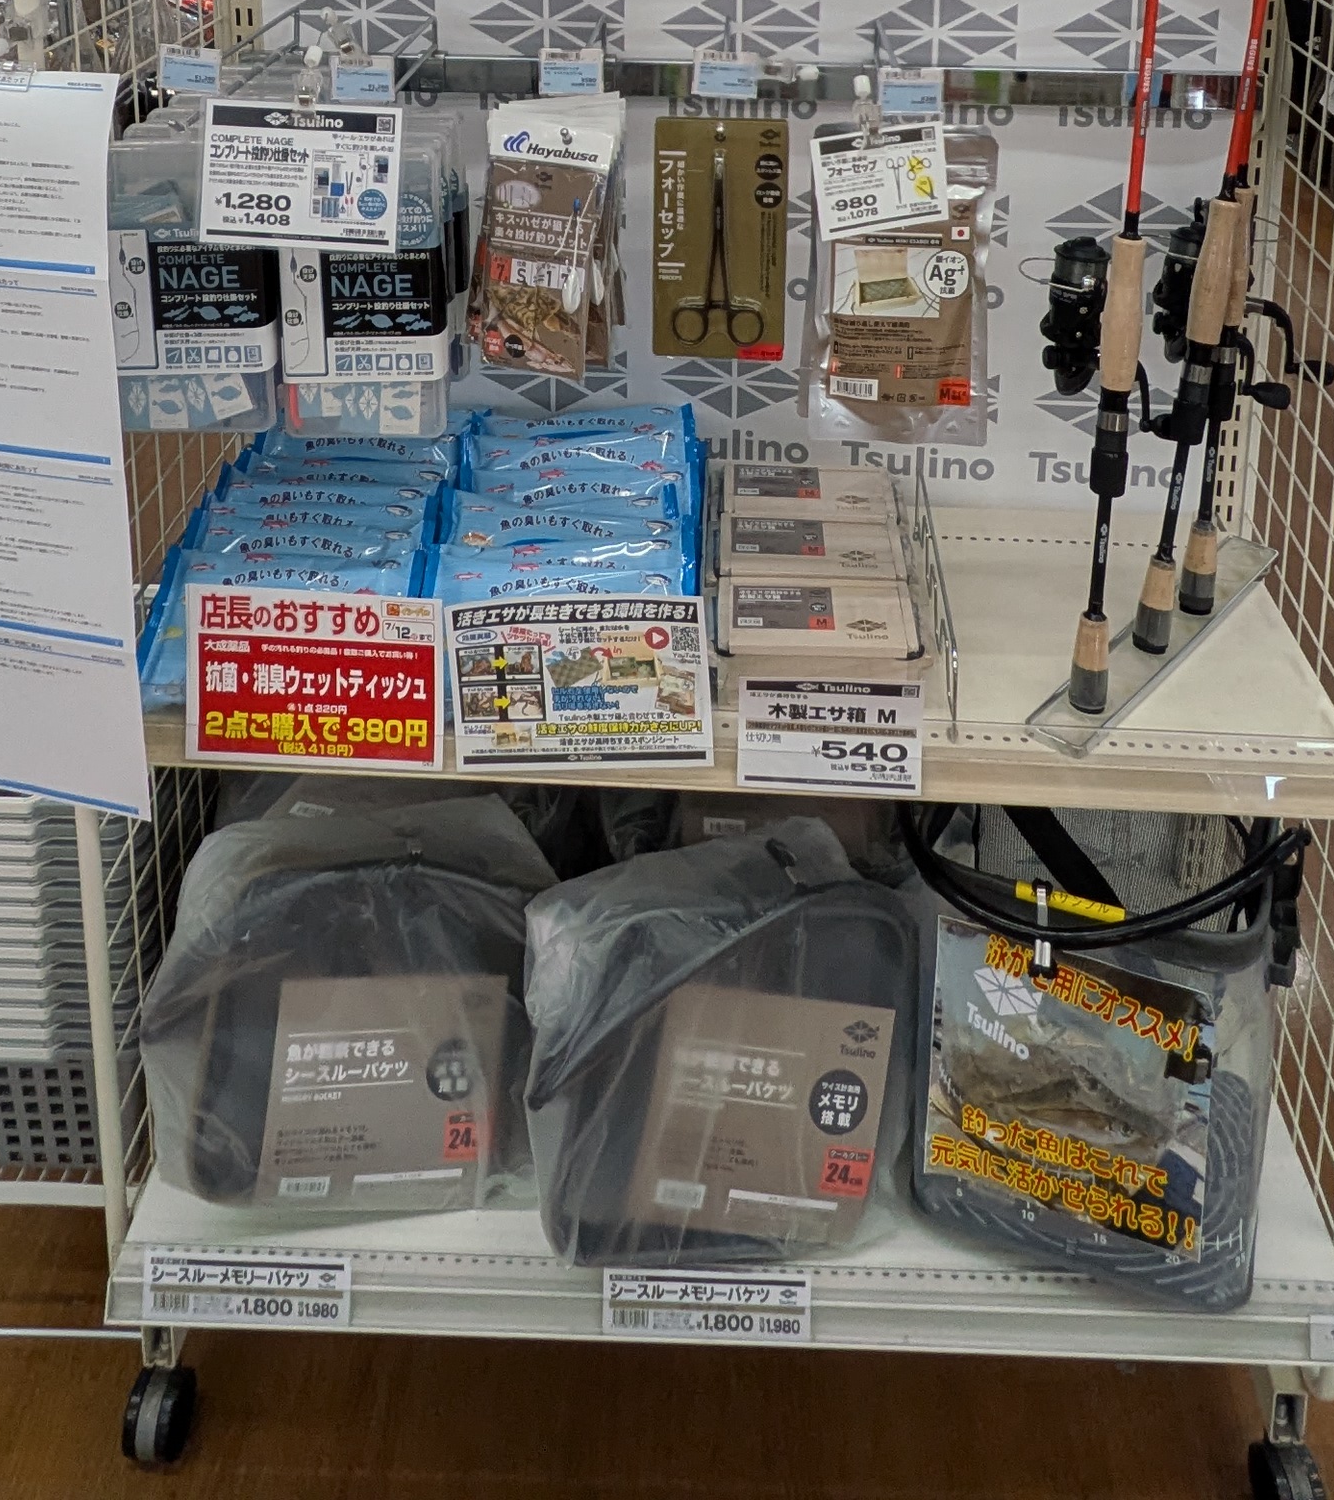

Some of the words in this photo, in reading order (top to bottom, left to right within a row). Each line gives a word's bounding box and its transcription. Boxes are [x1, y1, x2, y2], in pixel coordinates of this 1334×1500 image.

[211, 134, 262, 145] COMPLETE
[266, 136, 294, 146] NAGE
[526, 142, 599, 164] Hayabusa
[827, 160, 877, 178] フォーセップ
[215, 191, 292, 211] ¥1,280
[658, 160, 674, 258] フォーセップ
[158, 253, 225, 265] COMPLETE
[330, 262, 398, 273] COMPLETE
[159, 265, 240, 289] NAGE
[330, 274, 414, 297] NAGE
[200, 594, 380, 637] 店長のおすすめ
[457, 603, 694, 627] 活きエサが長生きできる環境を作る!
[205, 661, 427, 700] 抗菌・消臭ウェットティッシュ
[822, 683, 870, 694] Tsulino
[768, 704, 867, 723] 木製エサ箱
[877, 708, 896, 724] M
[278, 742, 354, 757] (税込418円)
[811, 740, 908, 762] ¥540
[985, 934, 1198, 1062] 泳が用にオススメ!
[967, 1002, 1029, 1061] Tsulino
[285, 1061, 409, 1084] シースルーバケツ
[818, 1094, 859, 1111] メモリ
[962, 1105, 1167, 1194] 釣った魚はこれで
[930, 1133, 1196, 1250] 元気に活かせられる!!
[1021, 1209, 1035, 1221] 10
[1094, 1233, 1107, 1245] 15
[150, 1266, 309, 1287] シースルーメモリーバケツ
[610, 1281, 769, 1303] シースルーメモリーバケツ
